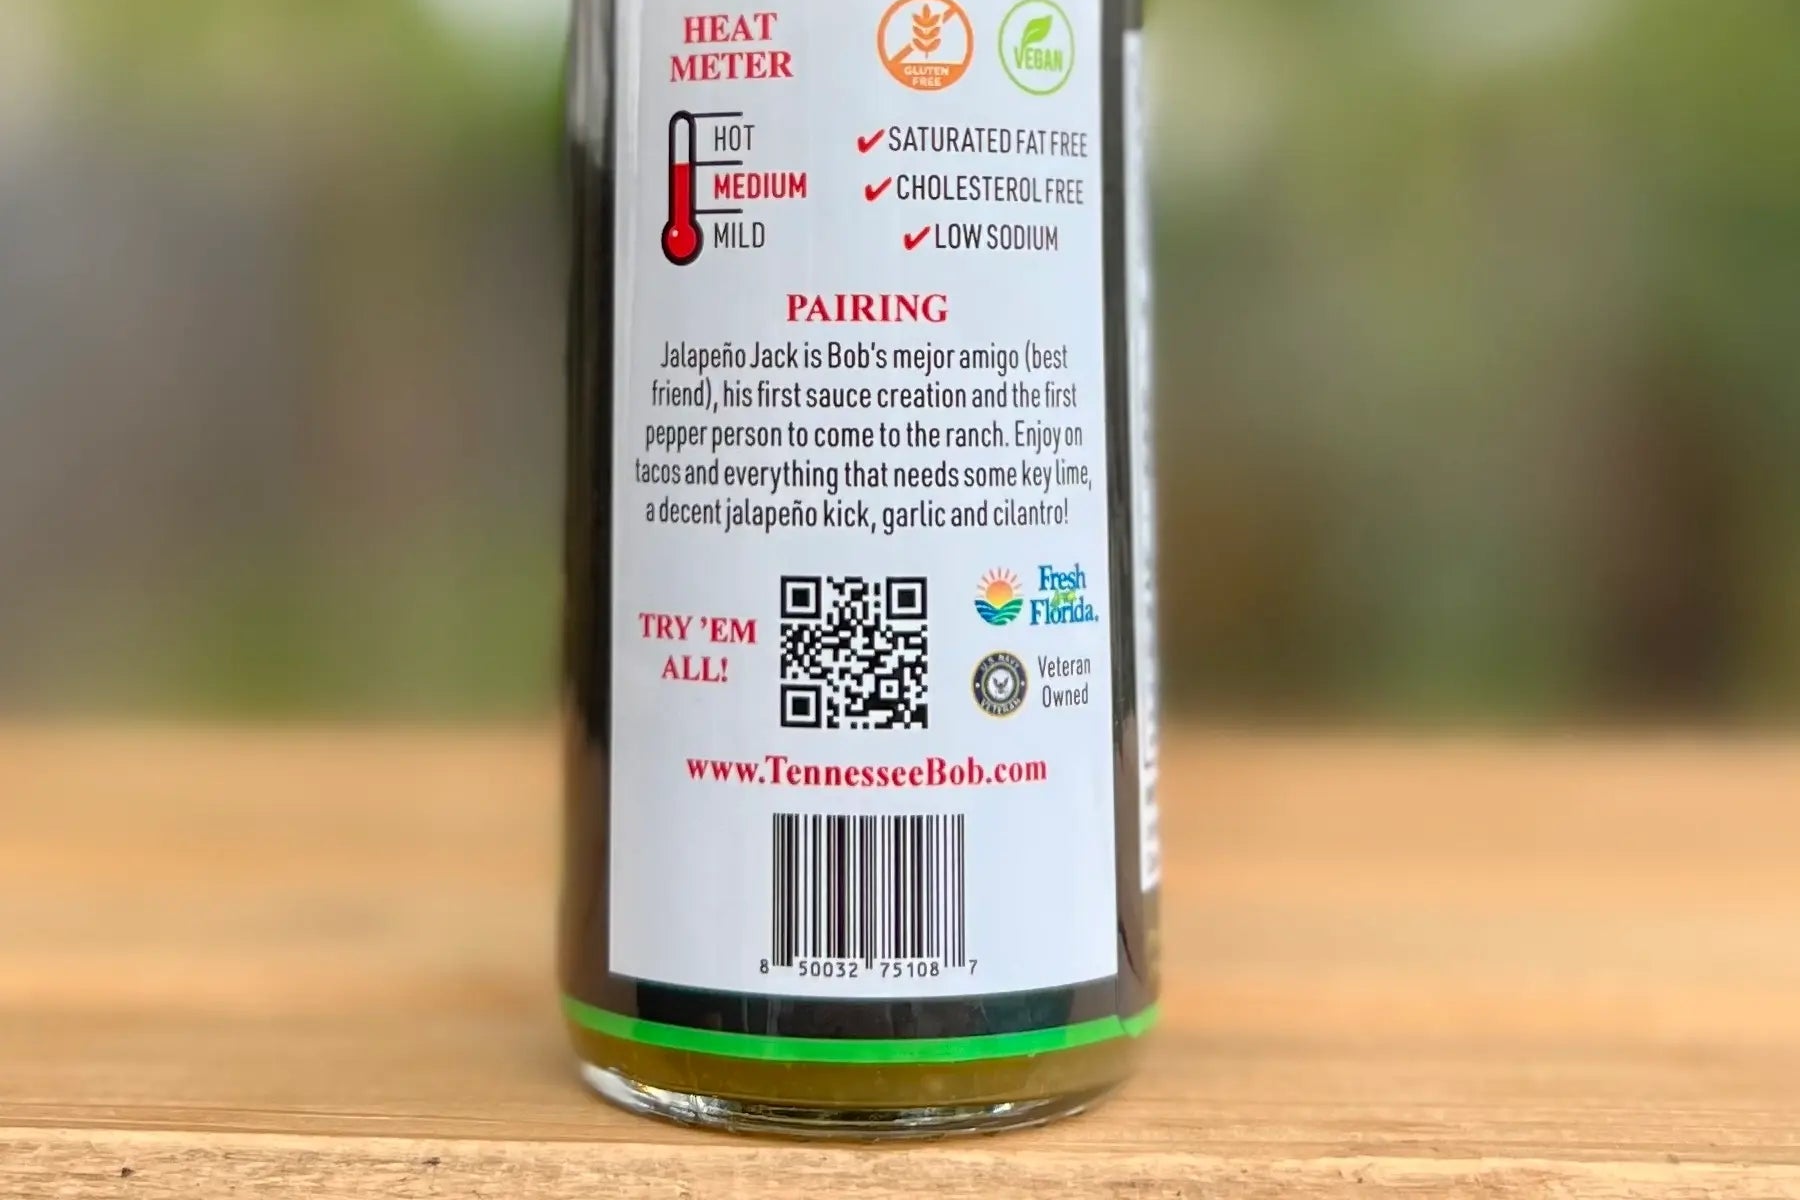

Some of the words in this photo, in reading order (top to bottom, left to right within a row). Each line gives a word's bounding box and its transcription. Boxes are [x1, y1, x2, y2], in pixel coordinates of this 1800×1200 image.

[683, 12, 777, 44] HEAT
[670, 50, 793, 83] METER
[904, 66, 949, 76] GLUTEN
[1014, 46, 1063, 71] VEGAN
[912, 77, 942, 86] FREE
[714, 125, 755, 151] HOT
[888, 126, 1012, 154] SATURATED
[1016, 129, 1047, 155] FAT
[1052, 131, 1088, 158] FREE
[714, 172, 807, 199] MEDIUM
[897, 175, 1042, 203] CHOLESTEROL
[1046, 179, 1084, 204] FREE
[714, 222, 765, 249] MILD
[935, 224, 981, 249] LOW
[987, 225, 1058, 251] SODIUM
[787, 293, 948, 323] PAIRING
[661, 341, 746, 376] Jalapeño
[750, 341, 798, 368] Jack
[804, 342, 822, 368] is
[828, 341, 887, 368] Bob's
[894, 342, 955, 376] mejor
[960, 342, 1019, 377] amigo
[1025, 339, 1068, 372] (best
[652, 377, 718, 414] friend),
[723, 380, 753, 407] his
[758, 380, 801, 408] first
[806, 388, 871, 408] sauce
[877, 381, 966, 408] creation
[972, 381, 1007, 408] and
[1012, 381, 1040, 408] the
[1045, 381, 1077, 408] first
[646, 425, 708, 453] pepper
[712, 425, 782, 453] person
[788, 422, 808, 447] to
[814, 427, 873, 447] come
[880, 422, 900, 447] to
[907, 421, 940, 447] the
[946, 421, 1009, 447] ranch.
[1015, 420, 1061, 454] Enjoy
[1065, 425, 1083, 447] on
[635, 458, 681, 484] tacos
[685, 458, 719, 485] and
[724, 460, 838, 495] everything
[845, 460, 888, 487] that
[894, 460, 959, 487] needs
[964, 467, 1017, 487] some
[1022, 459, 1052, 494] key
[1055, 458, 1092, 491] lime,
[646, 502, 655, 522] a
[659, 496, 721, 525] decent
[724, 498, 817, 533] jalapeño
[824, 500, 876, 534] kick,
[883, 500, 946, 535] garlic
[951, 500, 987, 526] and
[993, 498, 1069, 526] cilantro!
[1038, 562, 1087, 591] Fresh
[639, 612, 694, 640] TRY
[661, 654, 728, 682] ALL!
[1038, 655, 1091, 678] Veteran
[1042, 682, 1089, 708] Owned
[686, 755, 1047, 788] www.TennesseeBob.com
[760, 959, 769, 975] 8
[798, 961, 858, 978] 50032
[880, 961, 940, 978] 75108
[969, 959, 978, 975] 7
